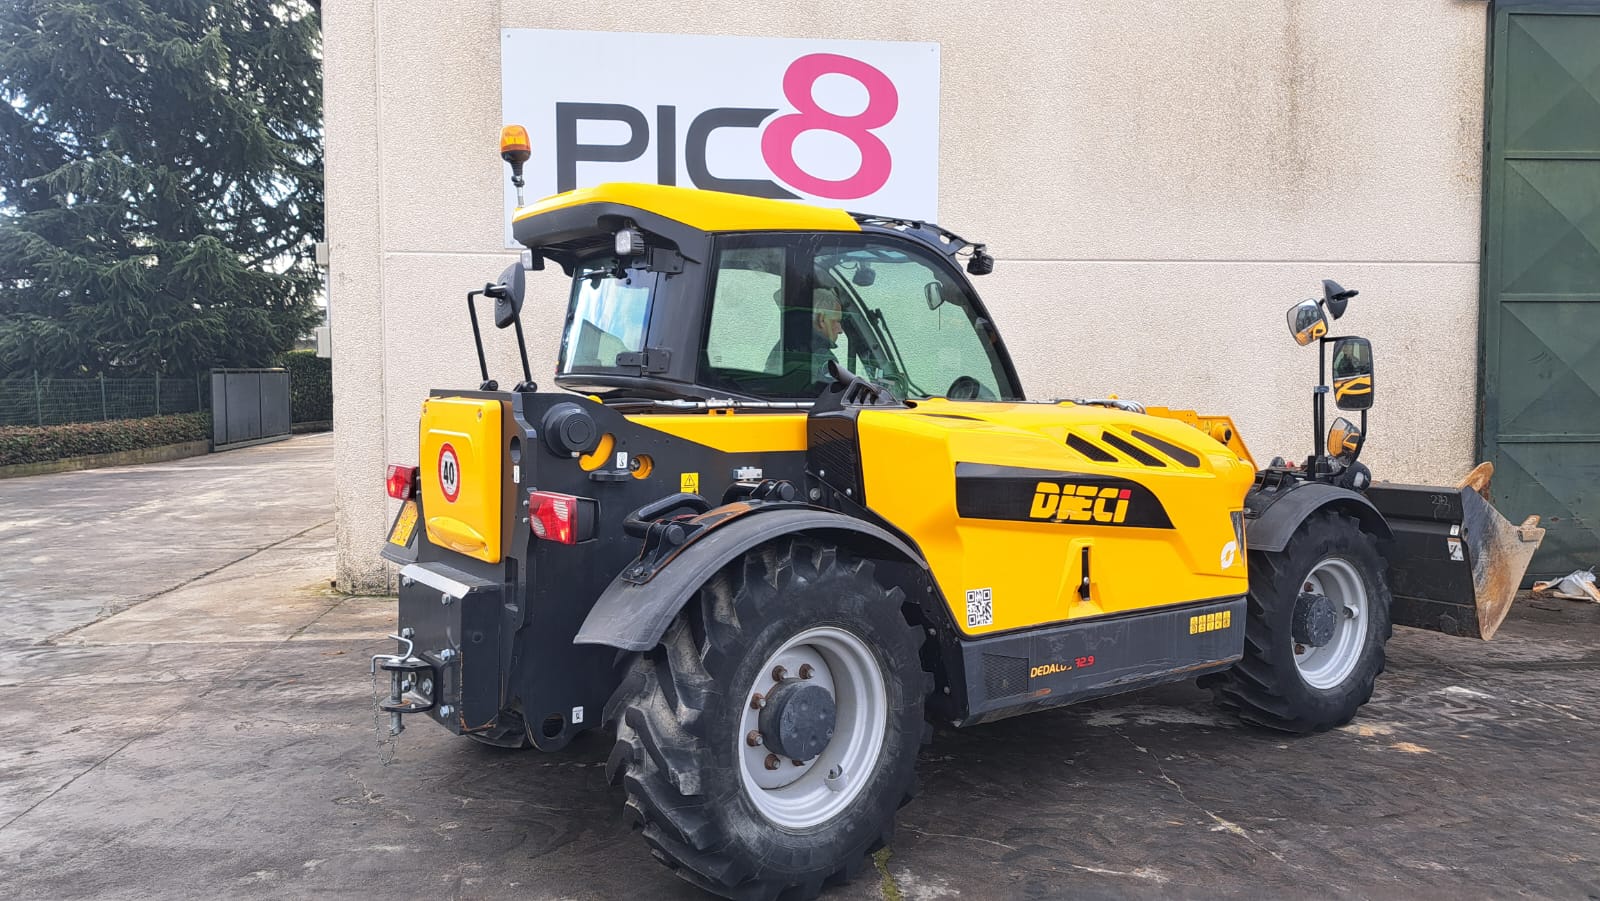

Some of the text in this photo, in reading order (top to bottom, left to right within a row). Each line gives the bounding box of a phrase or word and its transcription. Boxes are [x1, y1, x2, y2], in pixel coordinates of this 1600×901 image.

[556, 53, 899, 200] PIC8
[443, 460, 455, 485] 40
[1030, 481, 1132, 523] DIECI
